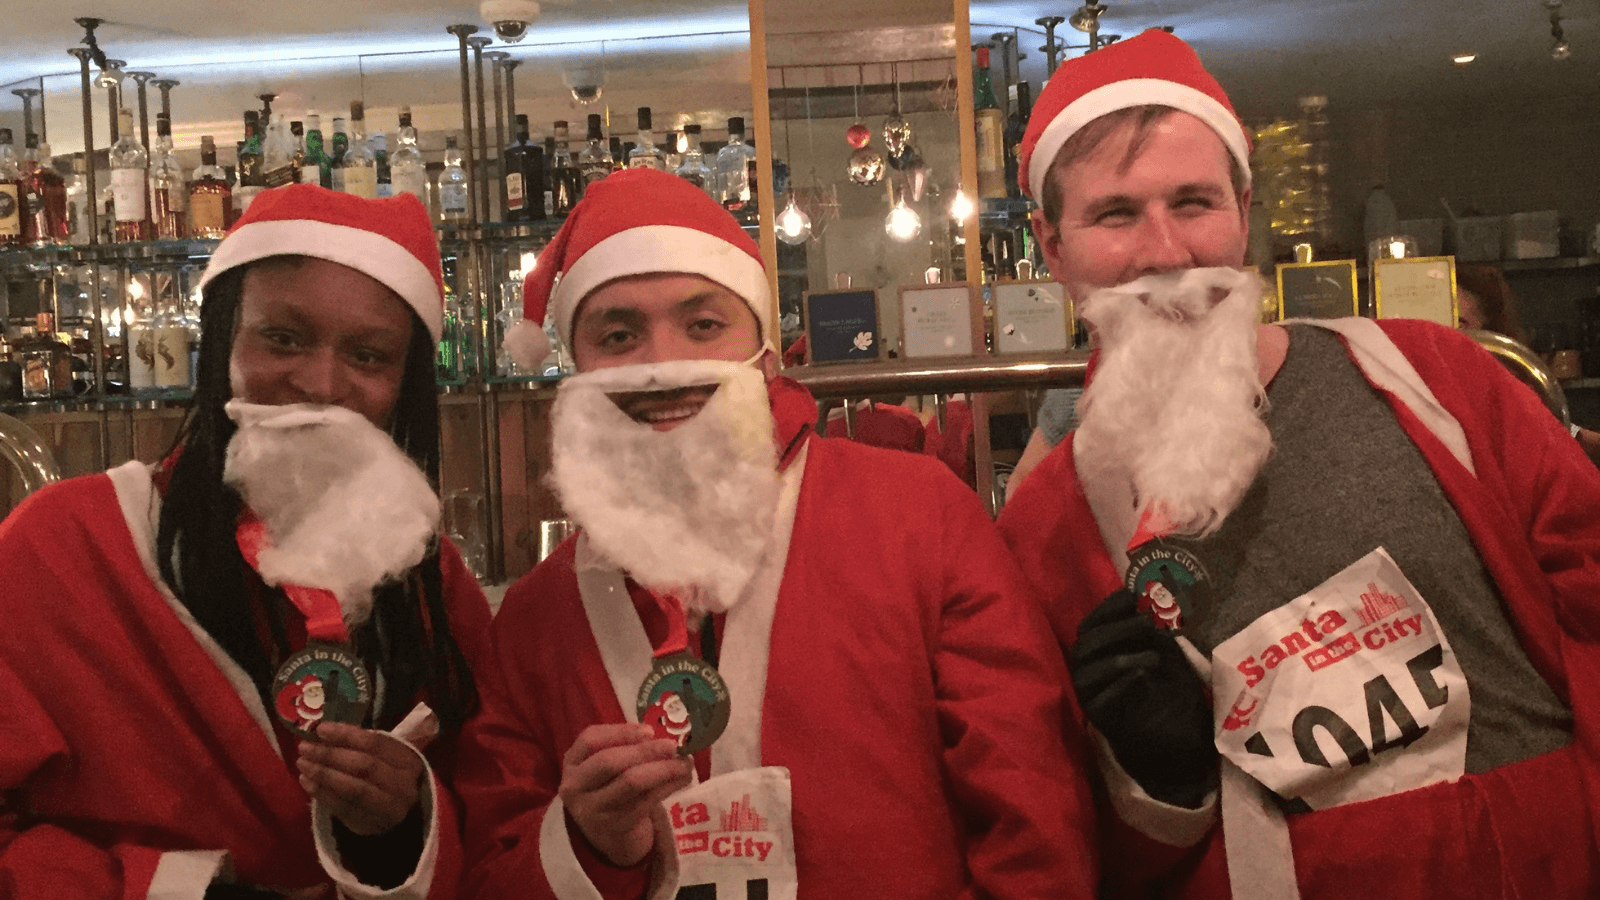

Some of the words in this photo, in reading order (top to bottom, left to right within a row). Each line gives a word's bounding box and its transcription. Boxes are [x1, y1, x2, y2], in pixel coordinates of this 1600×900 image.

[1137, 554, 1150, 567] in
[1151, 549, 1171, 560] the
[1174, 552, 1196, 572] City
[1237, 609, 1347, 688] Santa
[1362, 613, 1422, 650] City
[278, 653, 312, 682] Santa
[314, 649, 329, 660] in
[332, 652, 353, 667] the
[637, 672, 662, 708] Santa
[660, 664, 676, 675] in
[678, 660, 700, 672] the
[701, 667, 722, 690] City
[712, 836, 773, 861] City
